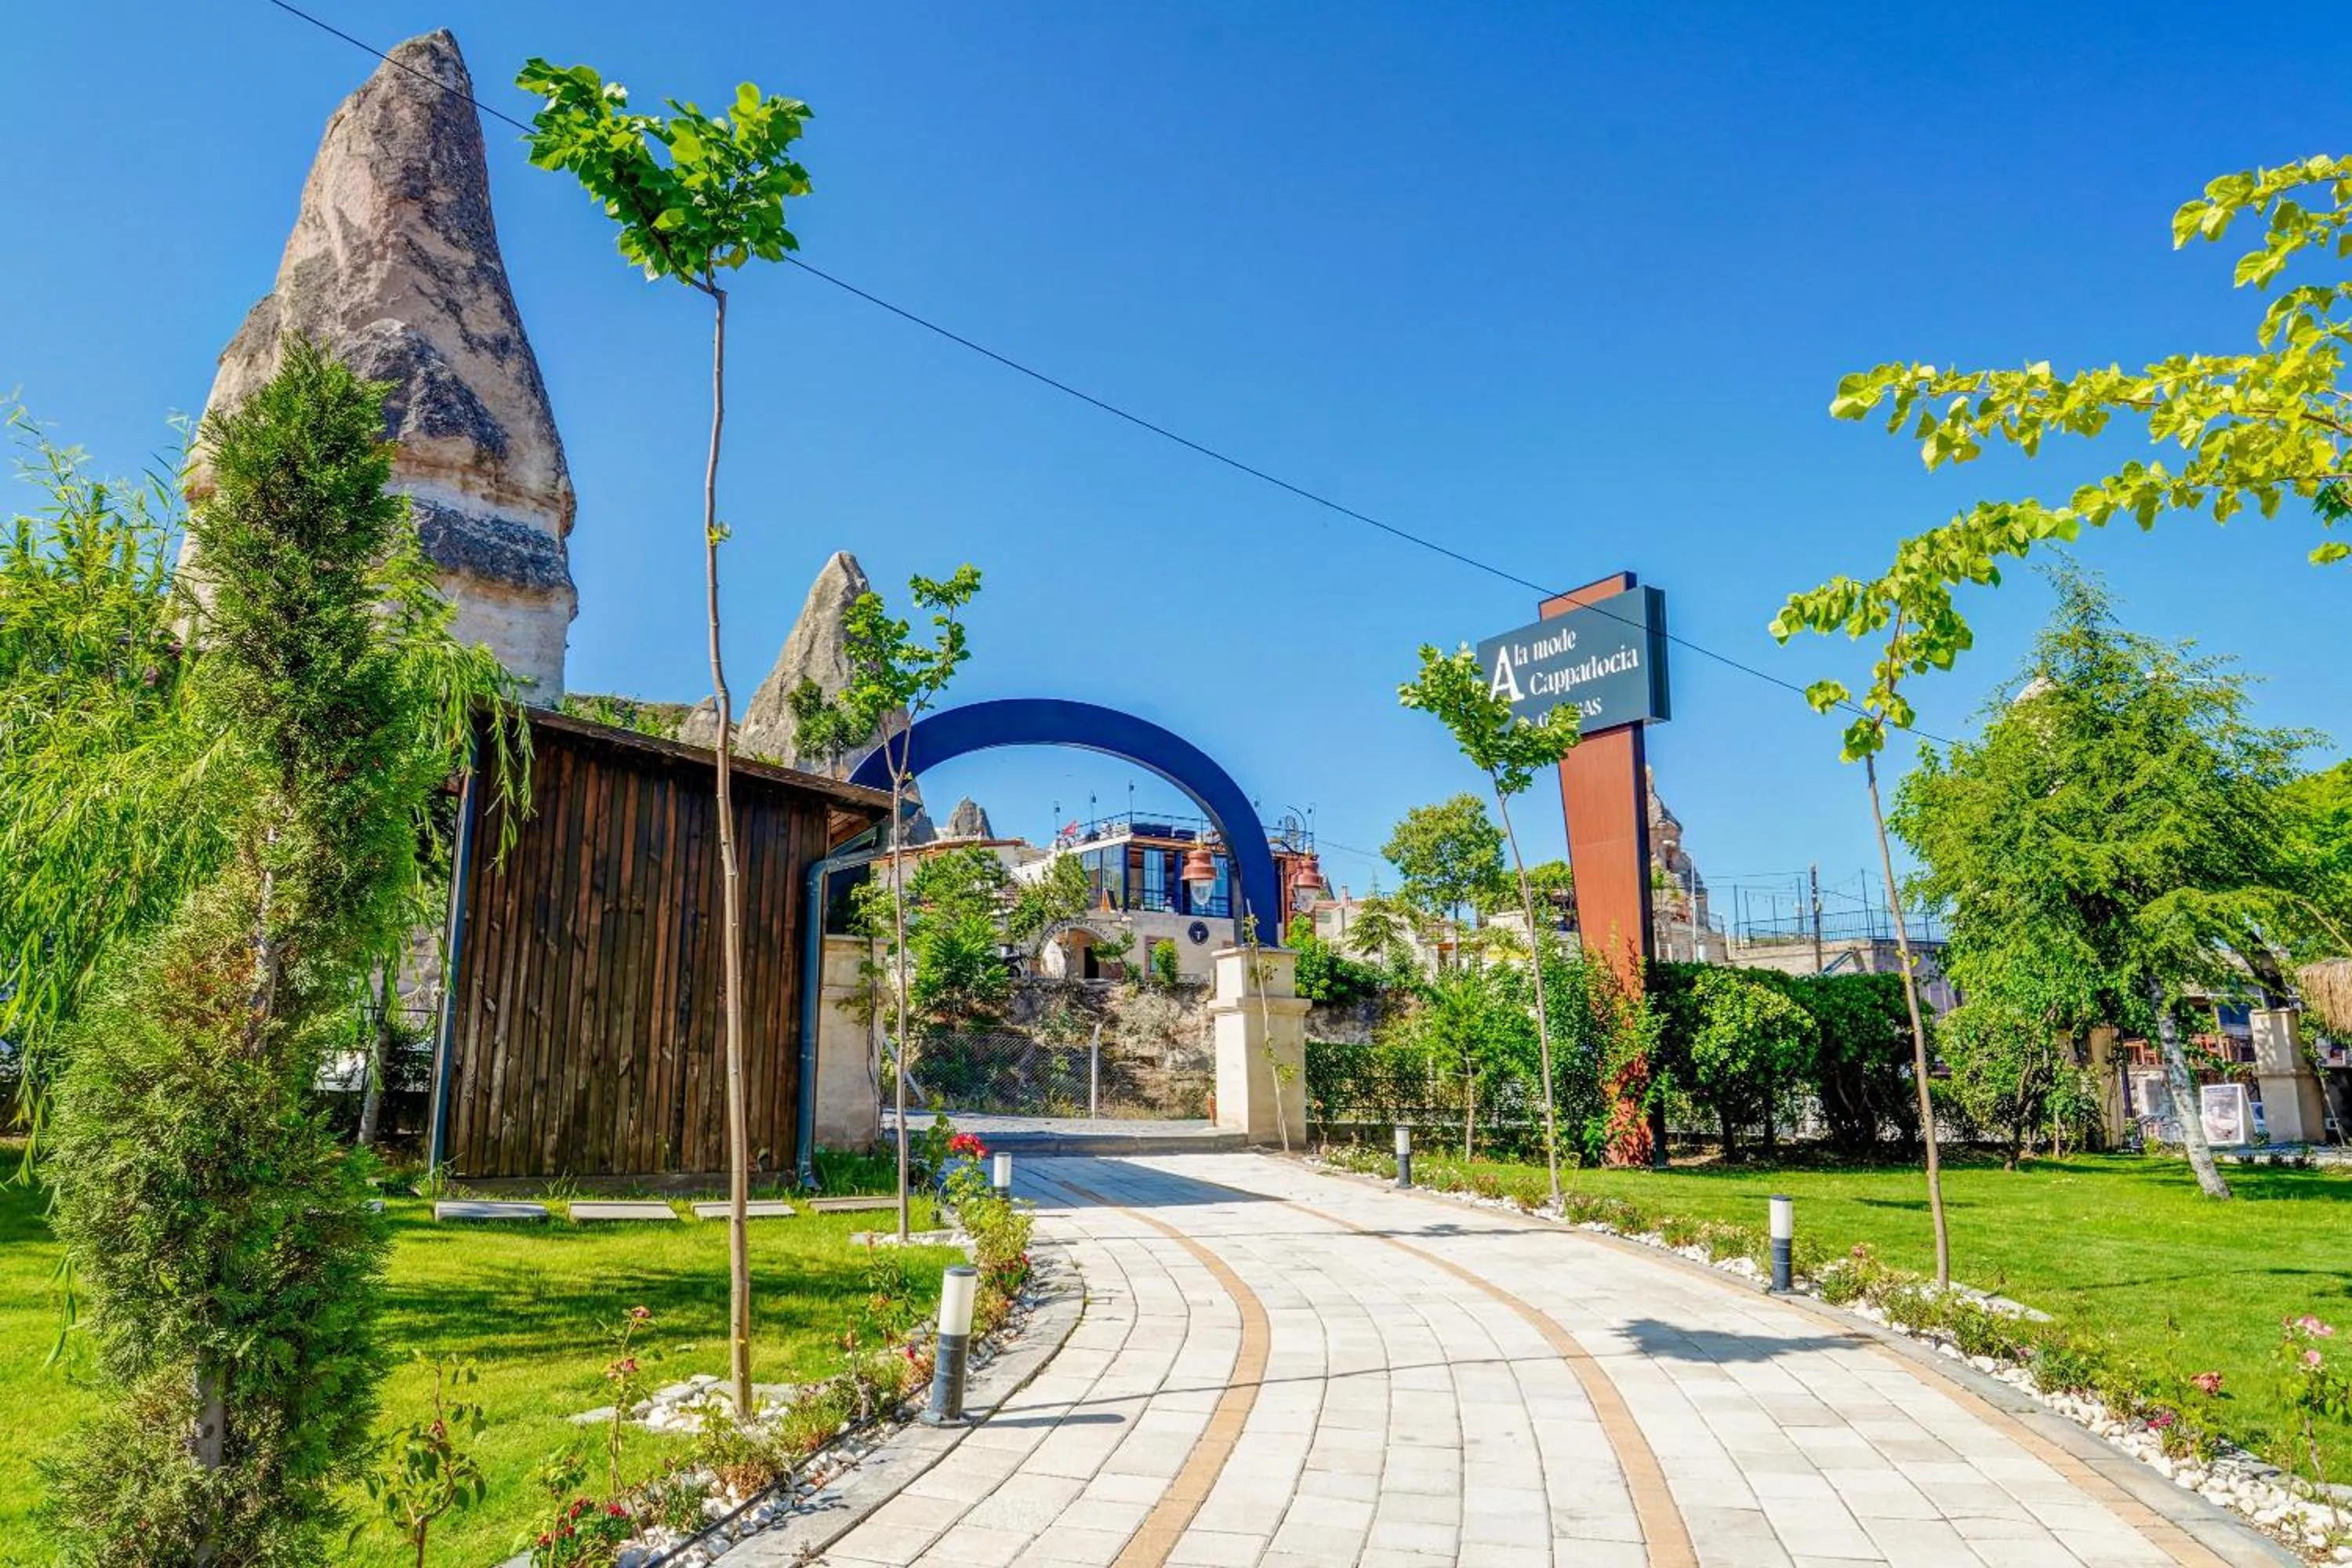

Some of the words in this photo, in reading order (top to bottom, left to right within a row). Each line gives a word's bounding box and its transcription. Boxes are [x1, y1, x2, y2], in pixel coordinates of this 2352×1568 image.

[1490, 645, 1525, 702] A
[1514, 644, 1528, 666] la
[1534, 628, 1577, 662] mode
[1530, 644, 1639, 695] Cappadocia
